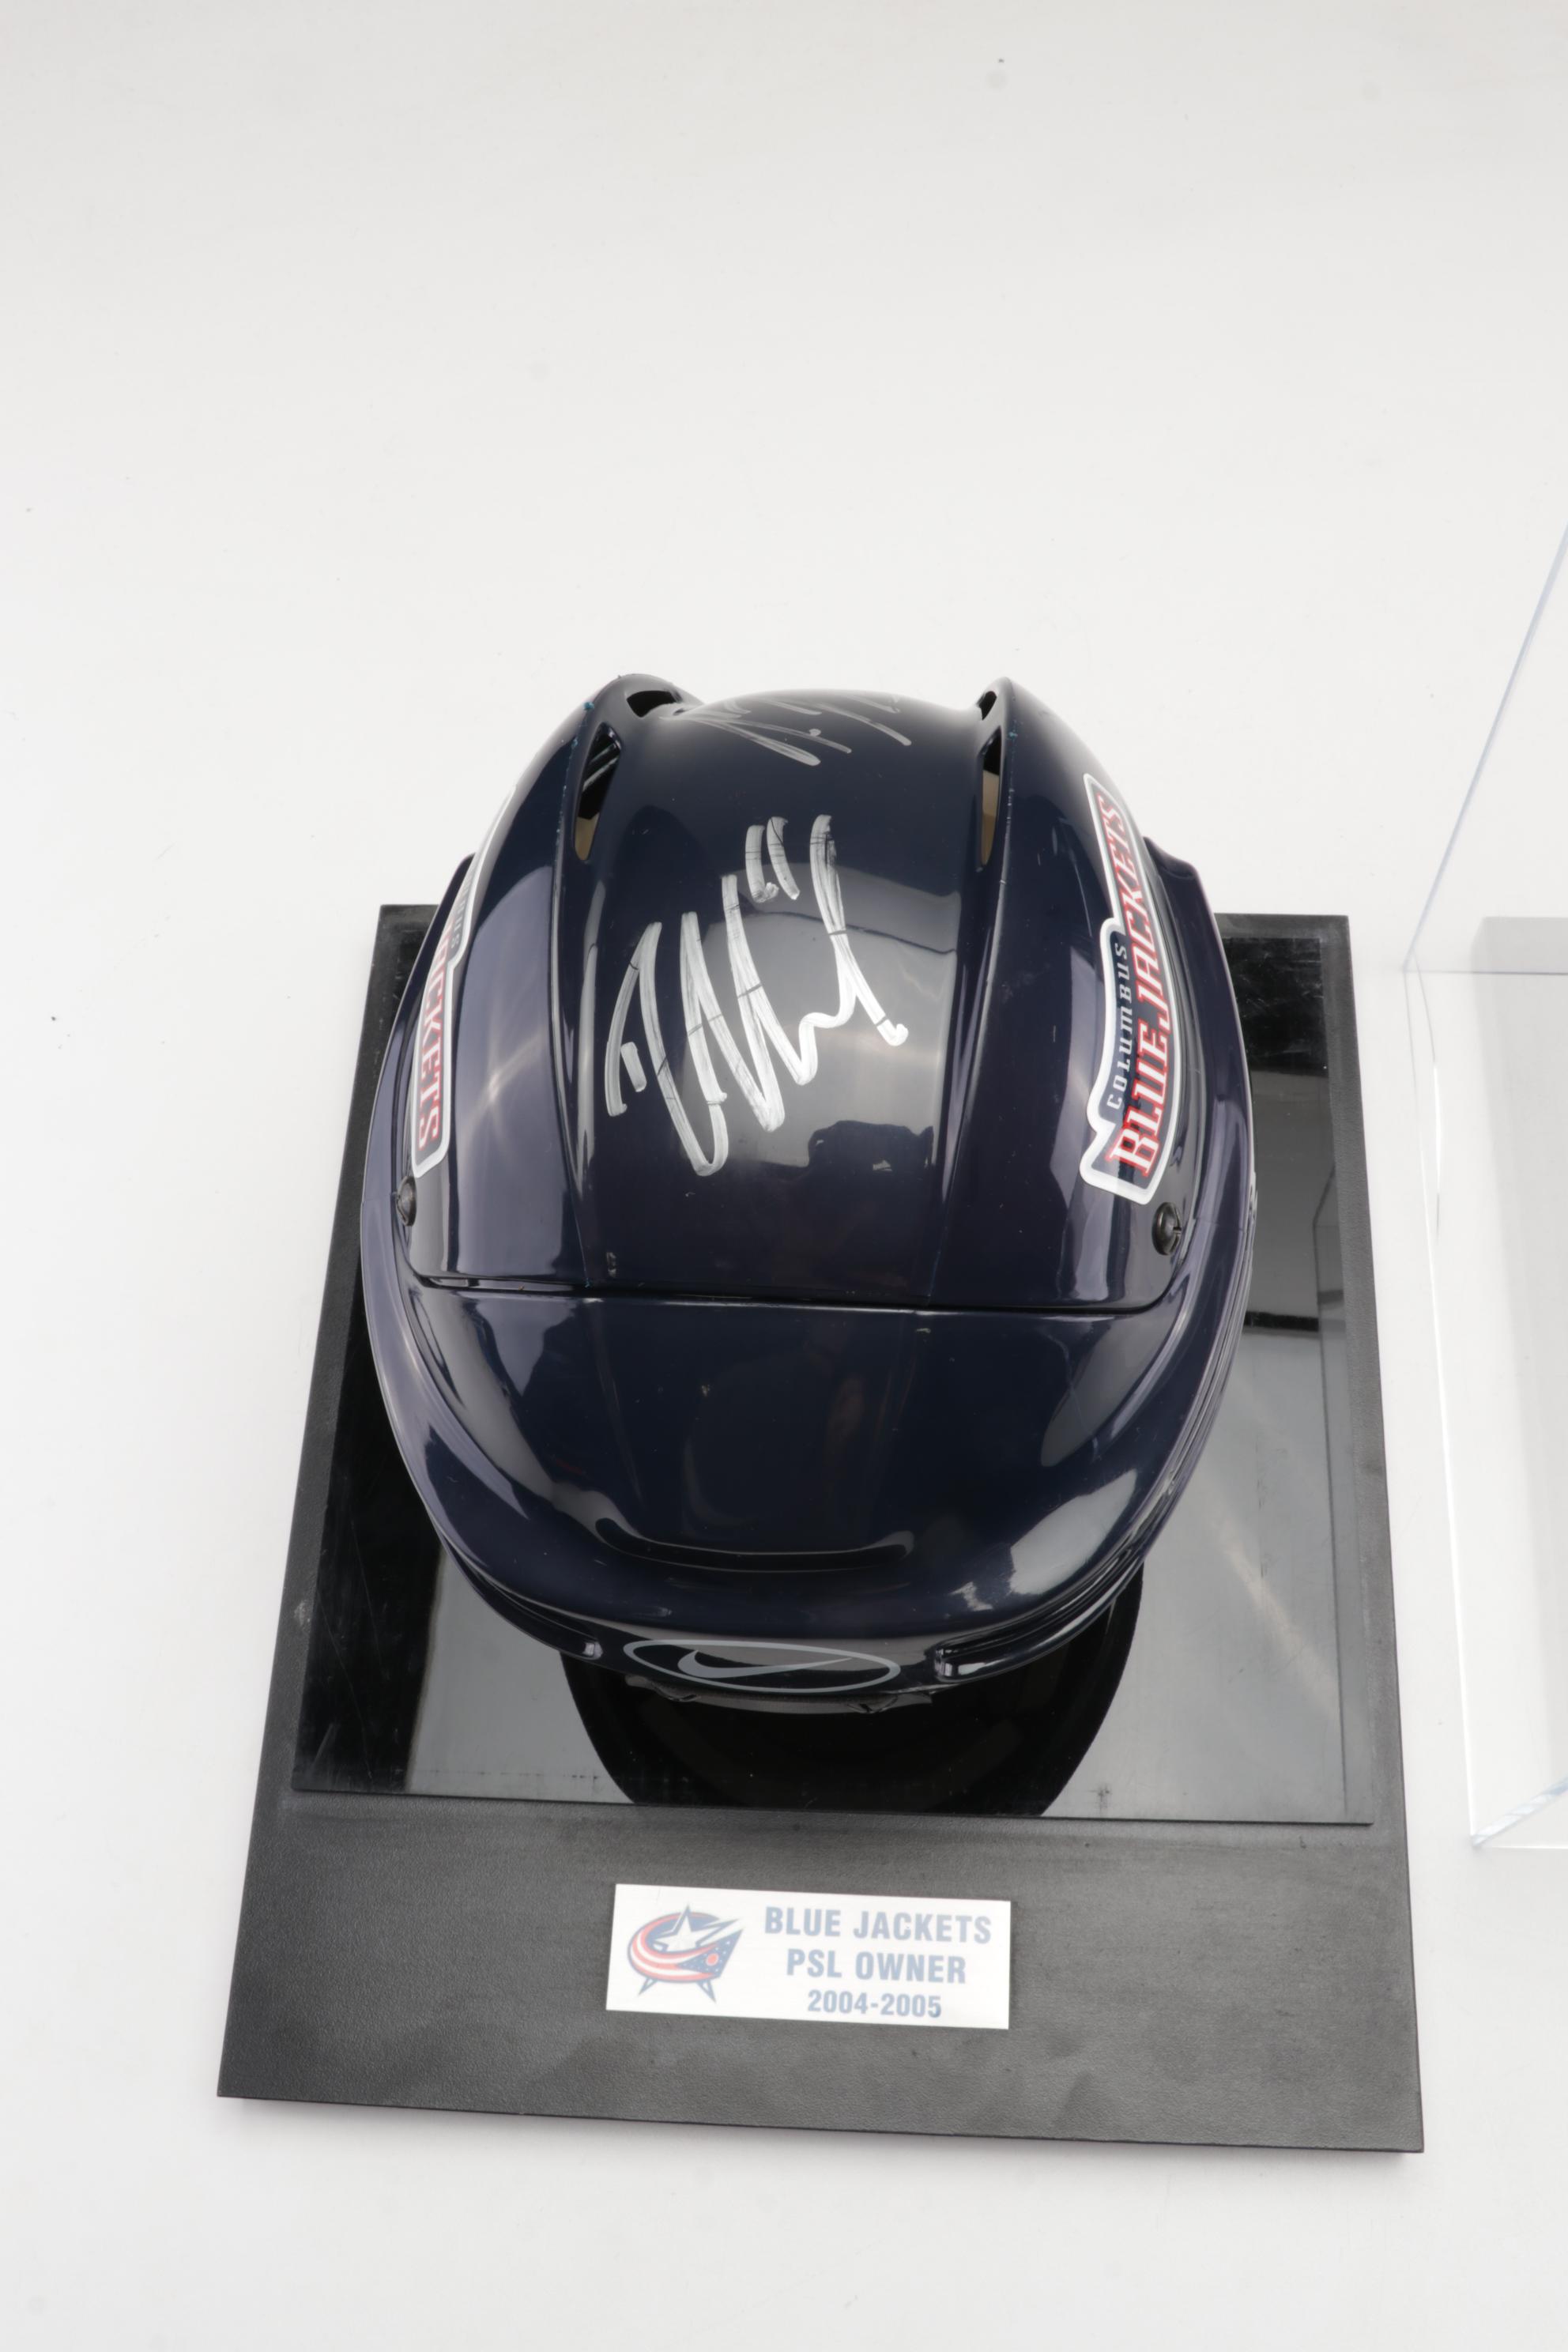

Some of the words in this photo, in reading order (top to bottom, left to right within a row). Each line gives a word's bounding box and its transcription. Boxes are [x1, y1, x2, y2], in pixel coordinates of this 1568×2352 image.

[1095, 793, 1171, 1034] JACKETS
[1106, 942, 1133, 1110] COLUMBUS
[1106, 1019, 1169, 1176] BLUE
[765, 1907, 840, 1936] BLUE
[854, 1911, 990, 1943] JACKETS
[787, 1949, 842, 1977] PSL
[856, 1952, 965, 1983] OWNER
[808, 1990, 941, 2018] 2004-2005
